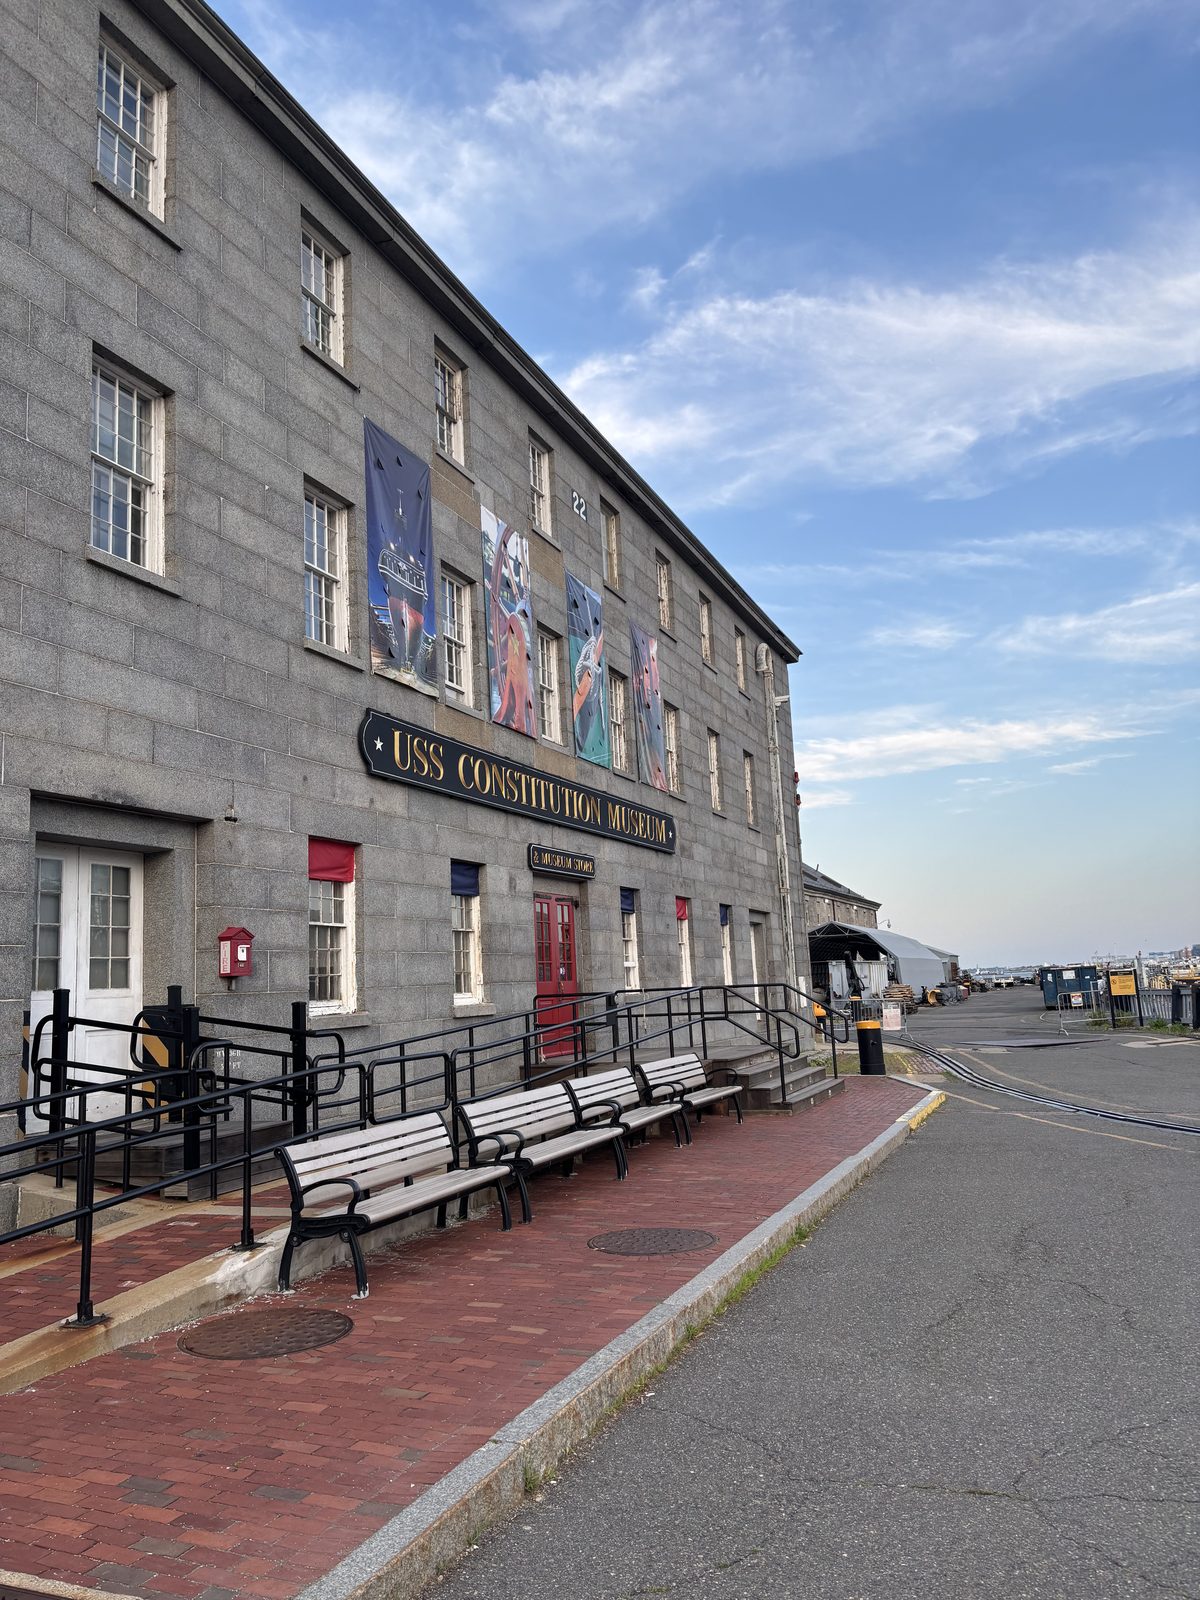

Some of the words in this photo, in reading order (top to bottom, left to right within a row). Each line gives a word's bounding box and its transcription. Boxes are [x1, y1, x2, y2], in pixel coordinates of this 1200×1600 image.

[572, 491, 587, 521] 22
[392, 728, 444, 781] USS
[458, 753, 601, 826] CONSTITUTION
[607, 801, 667, 844] MUSEUM
[533, 850, 539, 864] &
[541, 852, 572, 869] MUSEUM
[573, 858, 594, 873] STORE
